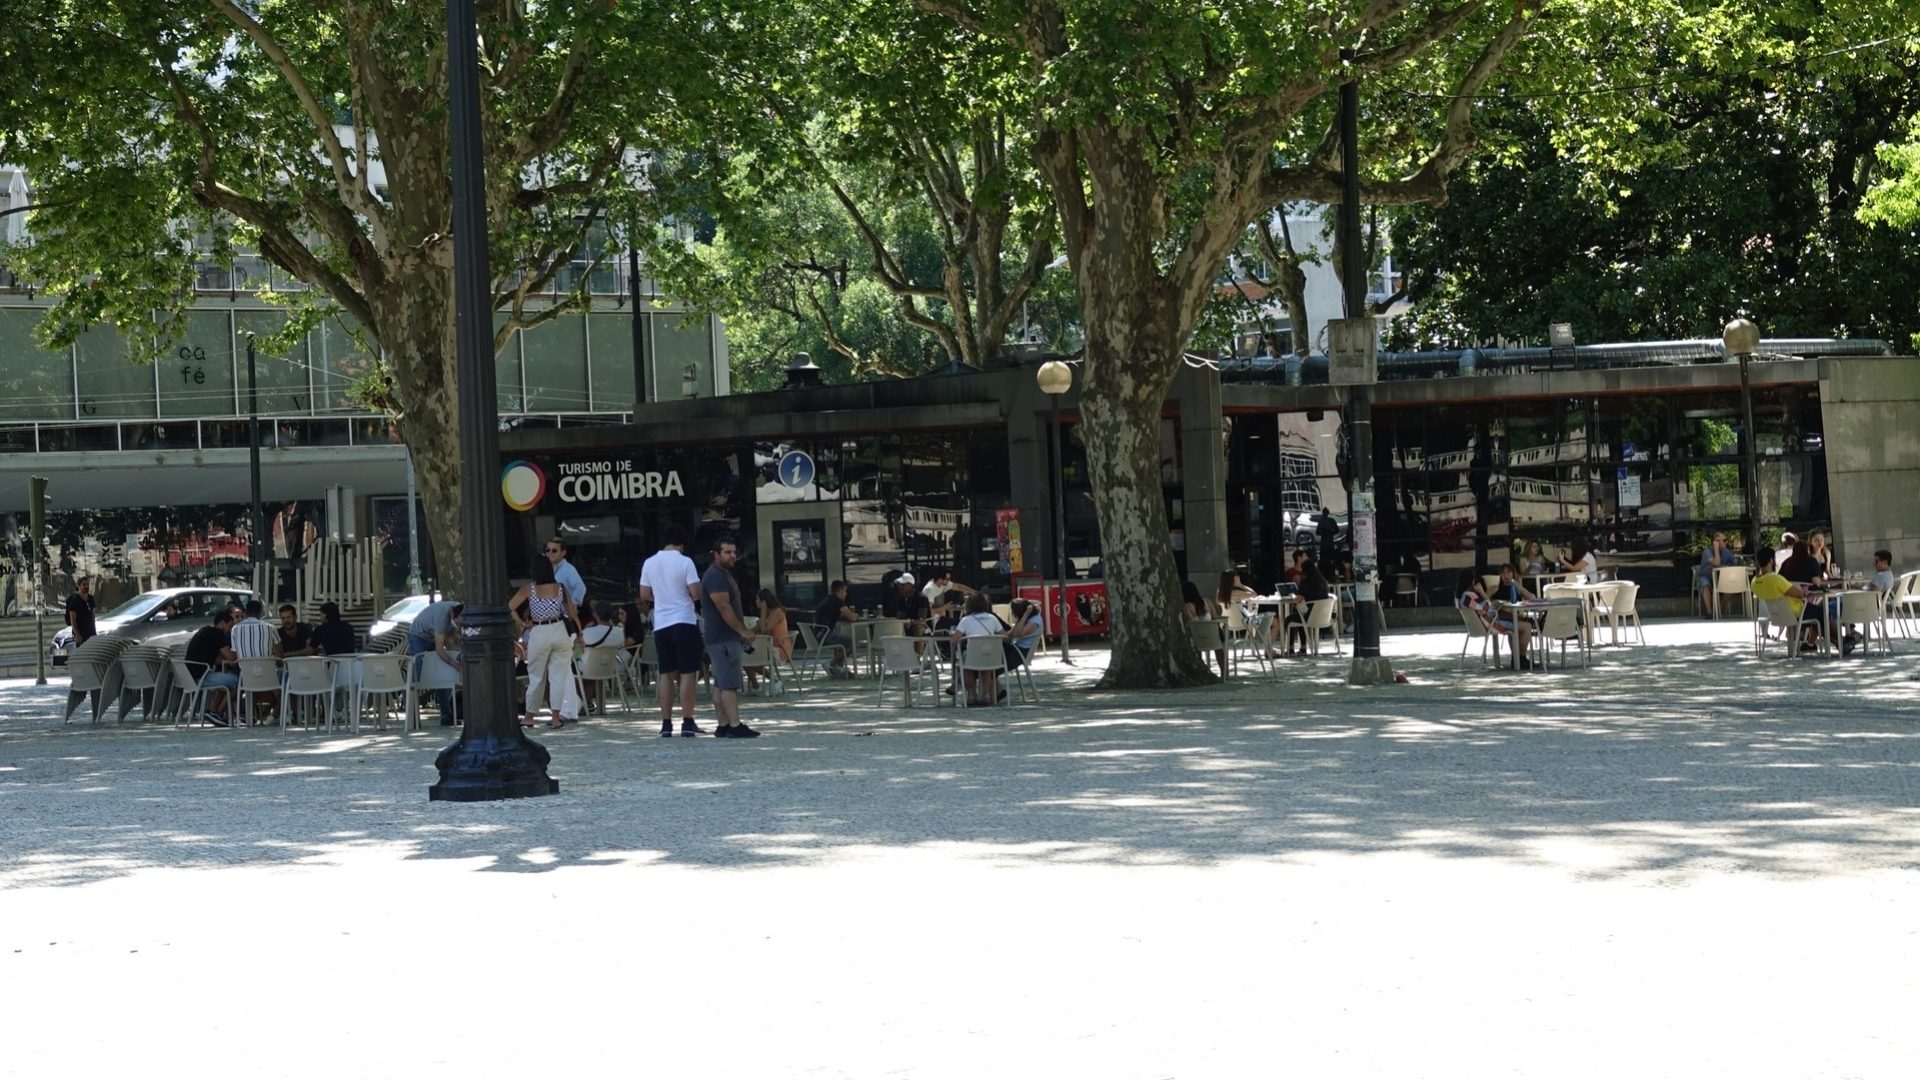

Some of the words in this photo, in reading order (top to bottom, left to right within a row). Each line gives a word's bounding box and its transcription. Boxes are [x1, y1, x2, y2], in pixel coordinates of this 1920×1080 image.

[179, 346, 206, 361] ca
[181, 366, 206, 385] fé
[558, 460, 611, 475] TURISMO
[616, 460, 632, 472] DE
[558, 470, 685, 502] COIMBRA
